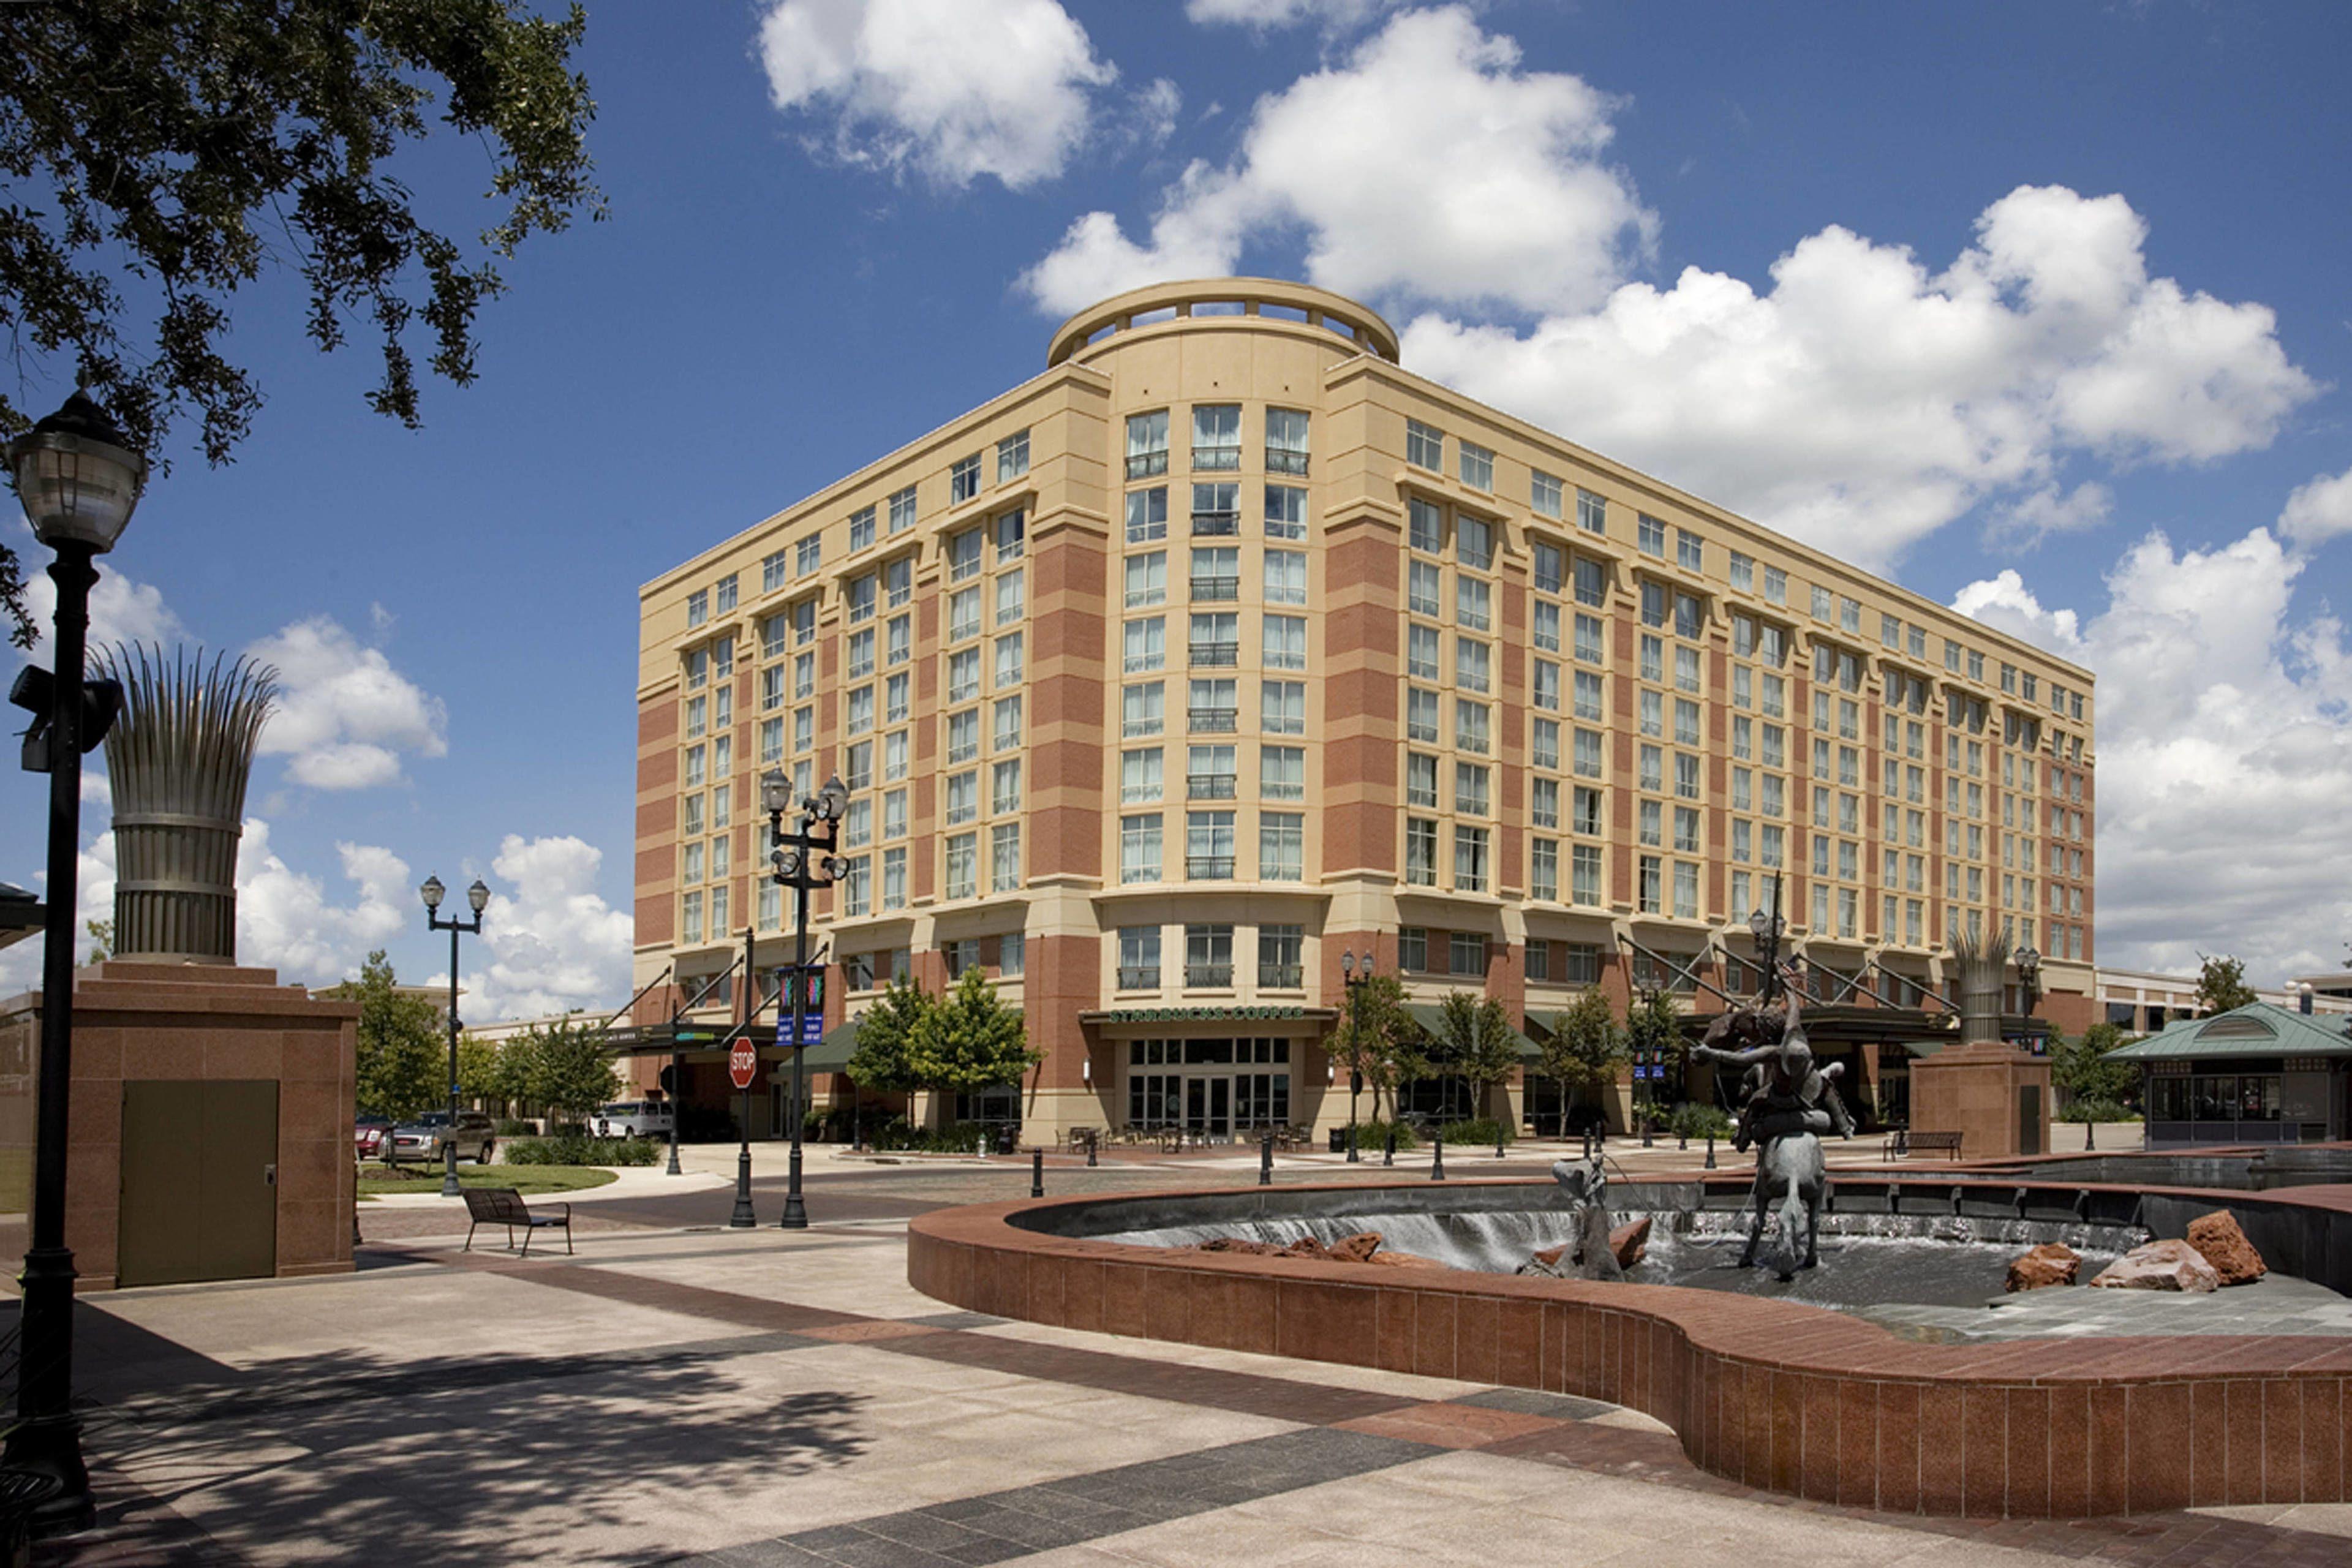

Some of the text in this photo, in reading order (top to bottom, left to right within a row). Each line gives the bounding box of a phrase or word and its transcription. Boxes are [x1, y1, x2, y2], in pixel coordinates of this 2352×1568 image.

[1109, 1006, 1303, 1023] STARBUCKS COFFEE
[733, 1052, 755, 1070] STOP
